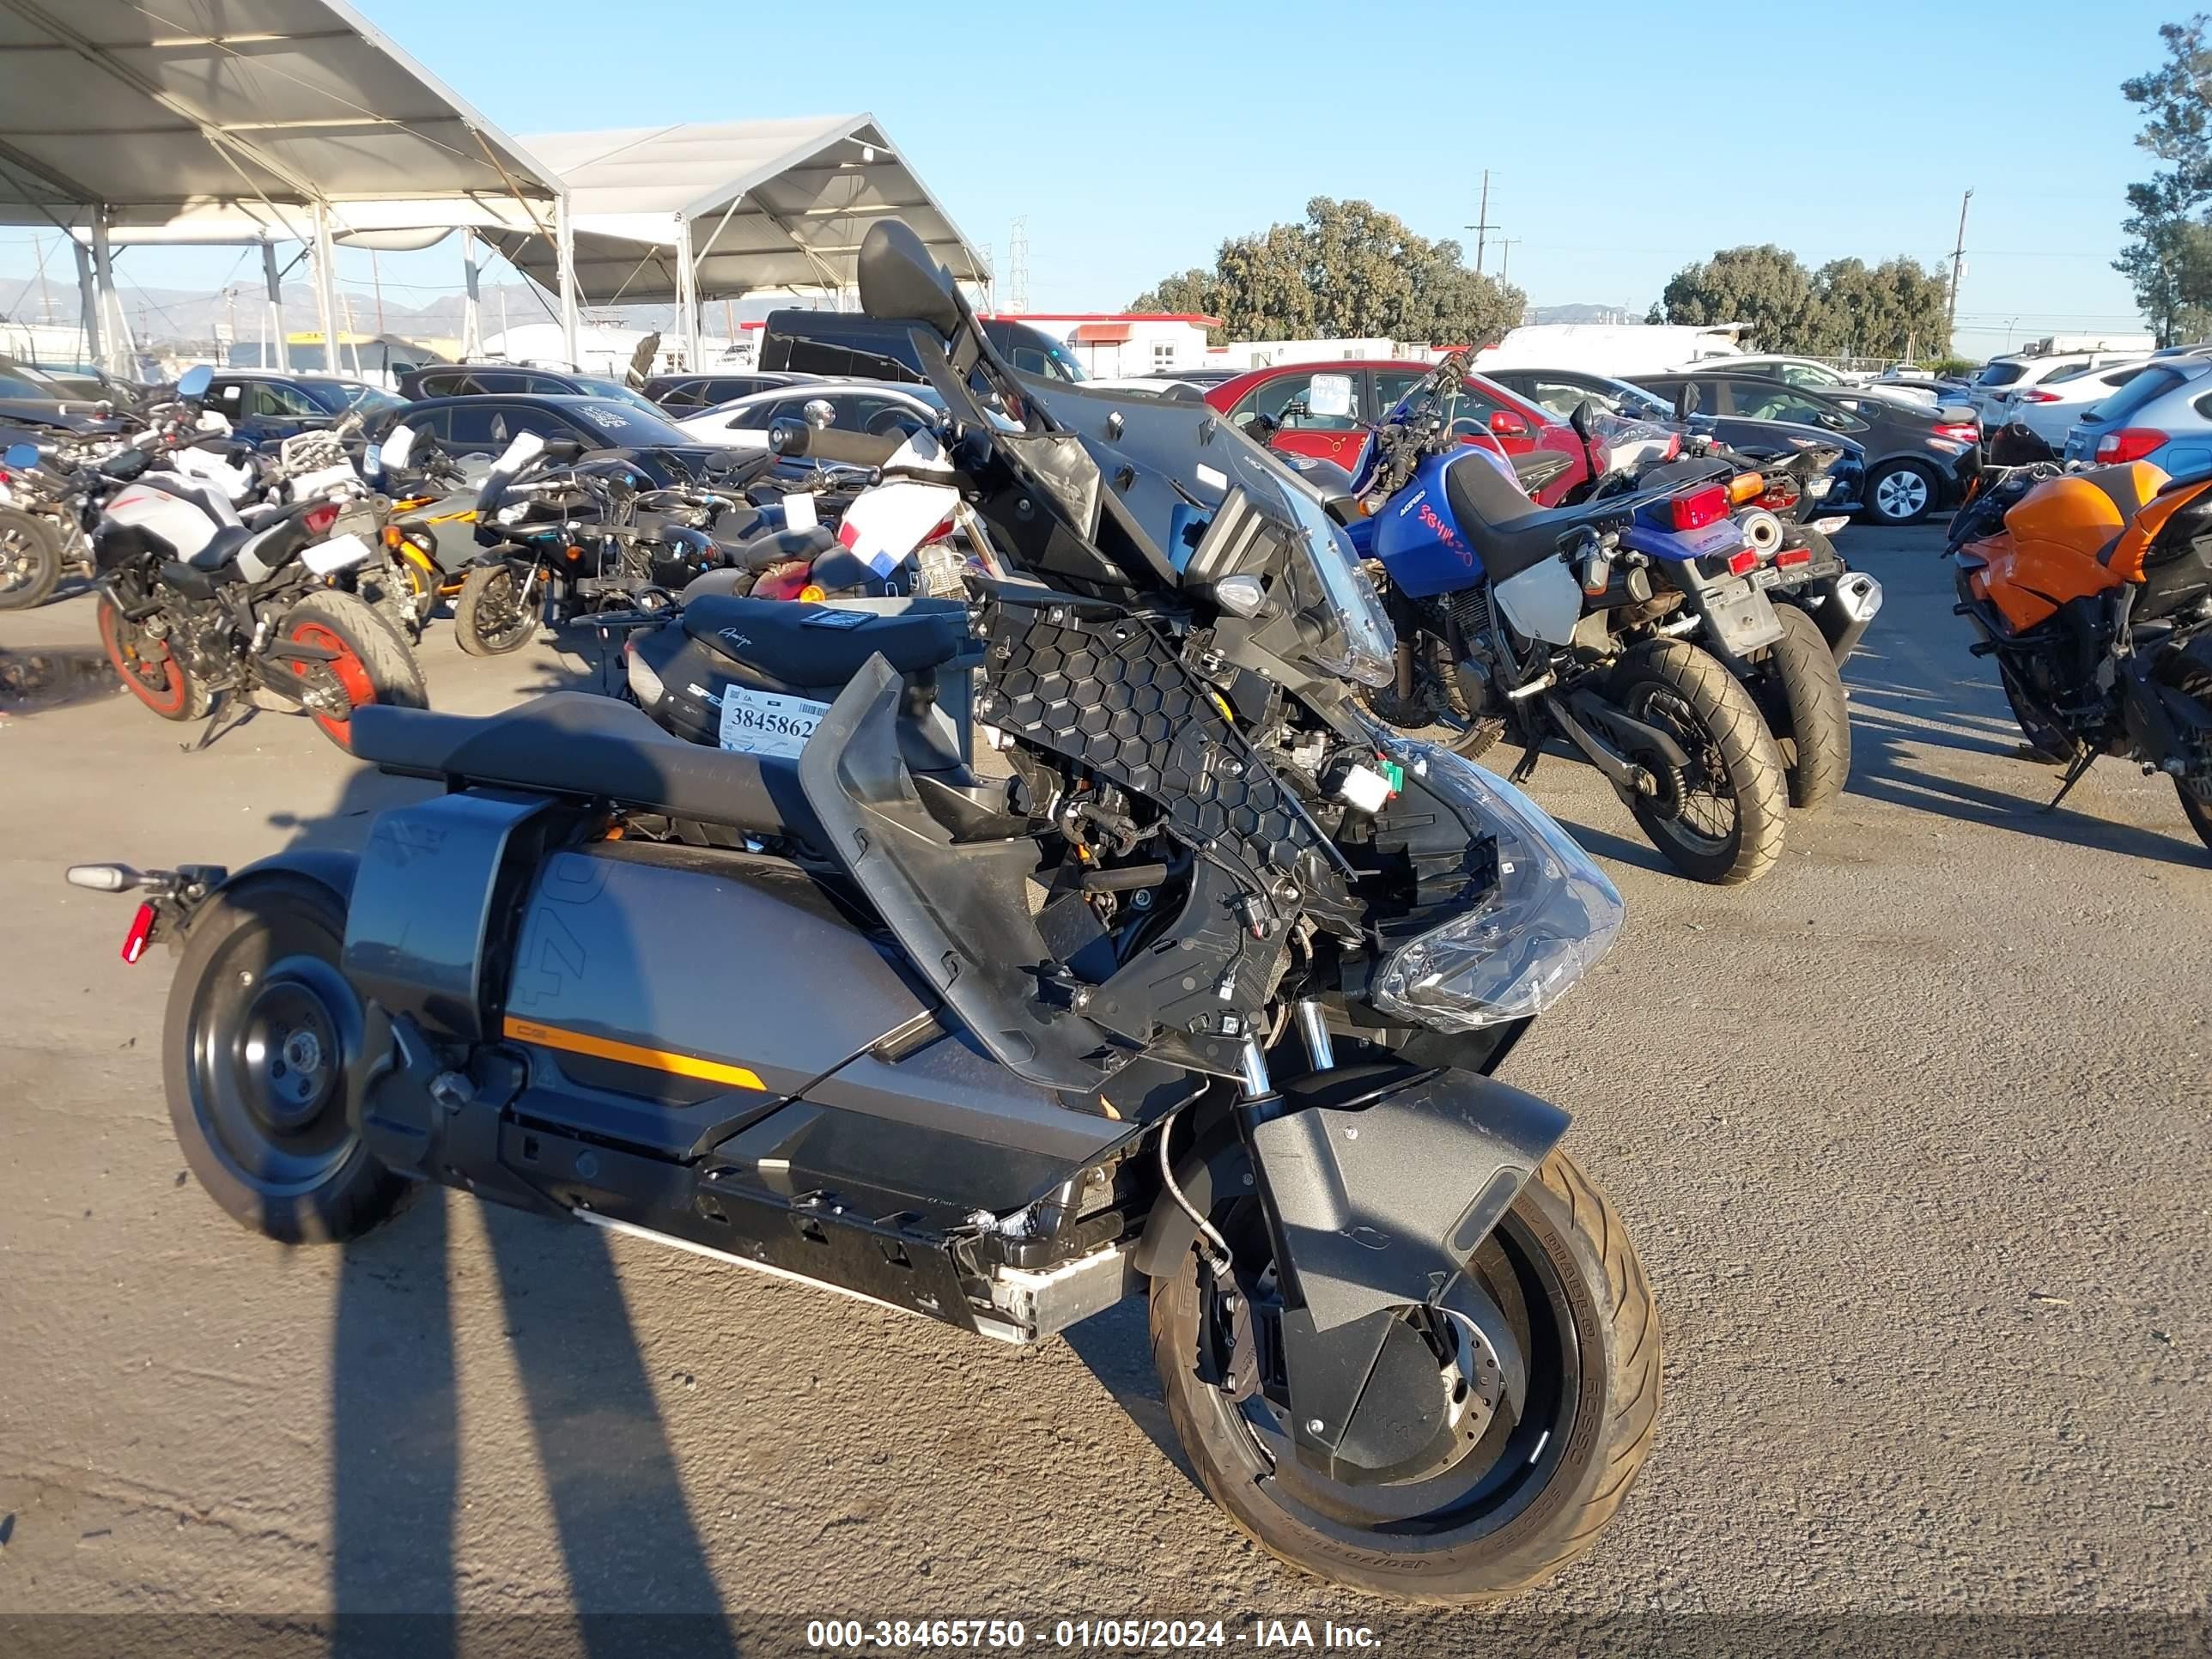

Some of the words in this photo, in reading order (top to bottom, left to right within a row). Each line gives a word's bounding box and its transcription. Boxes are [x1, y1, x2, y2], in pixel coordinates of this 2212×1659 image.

[687, 683, 723, 707] SPE
[731, 707, 819, 738] 3845862
[1544, 1231, 1596, 1338] DIABLO
